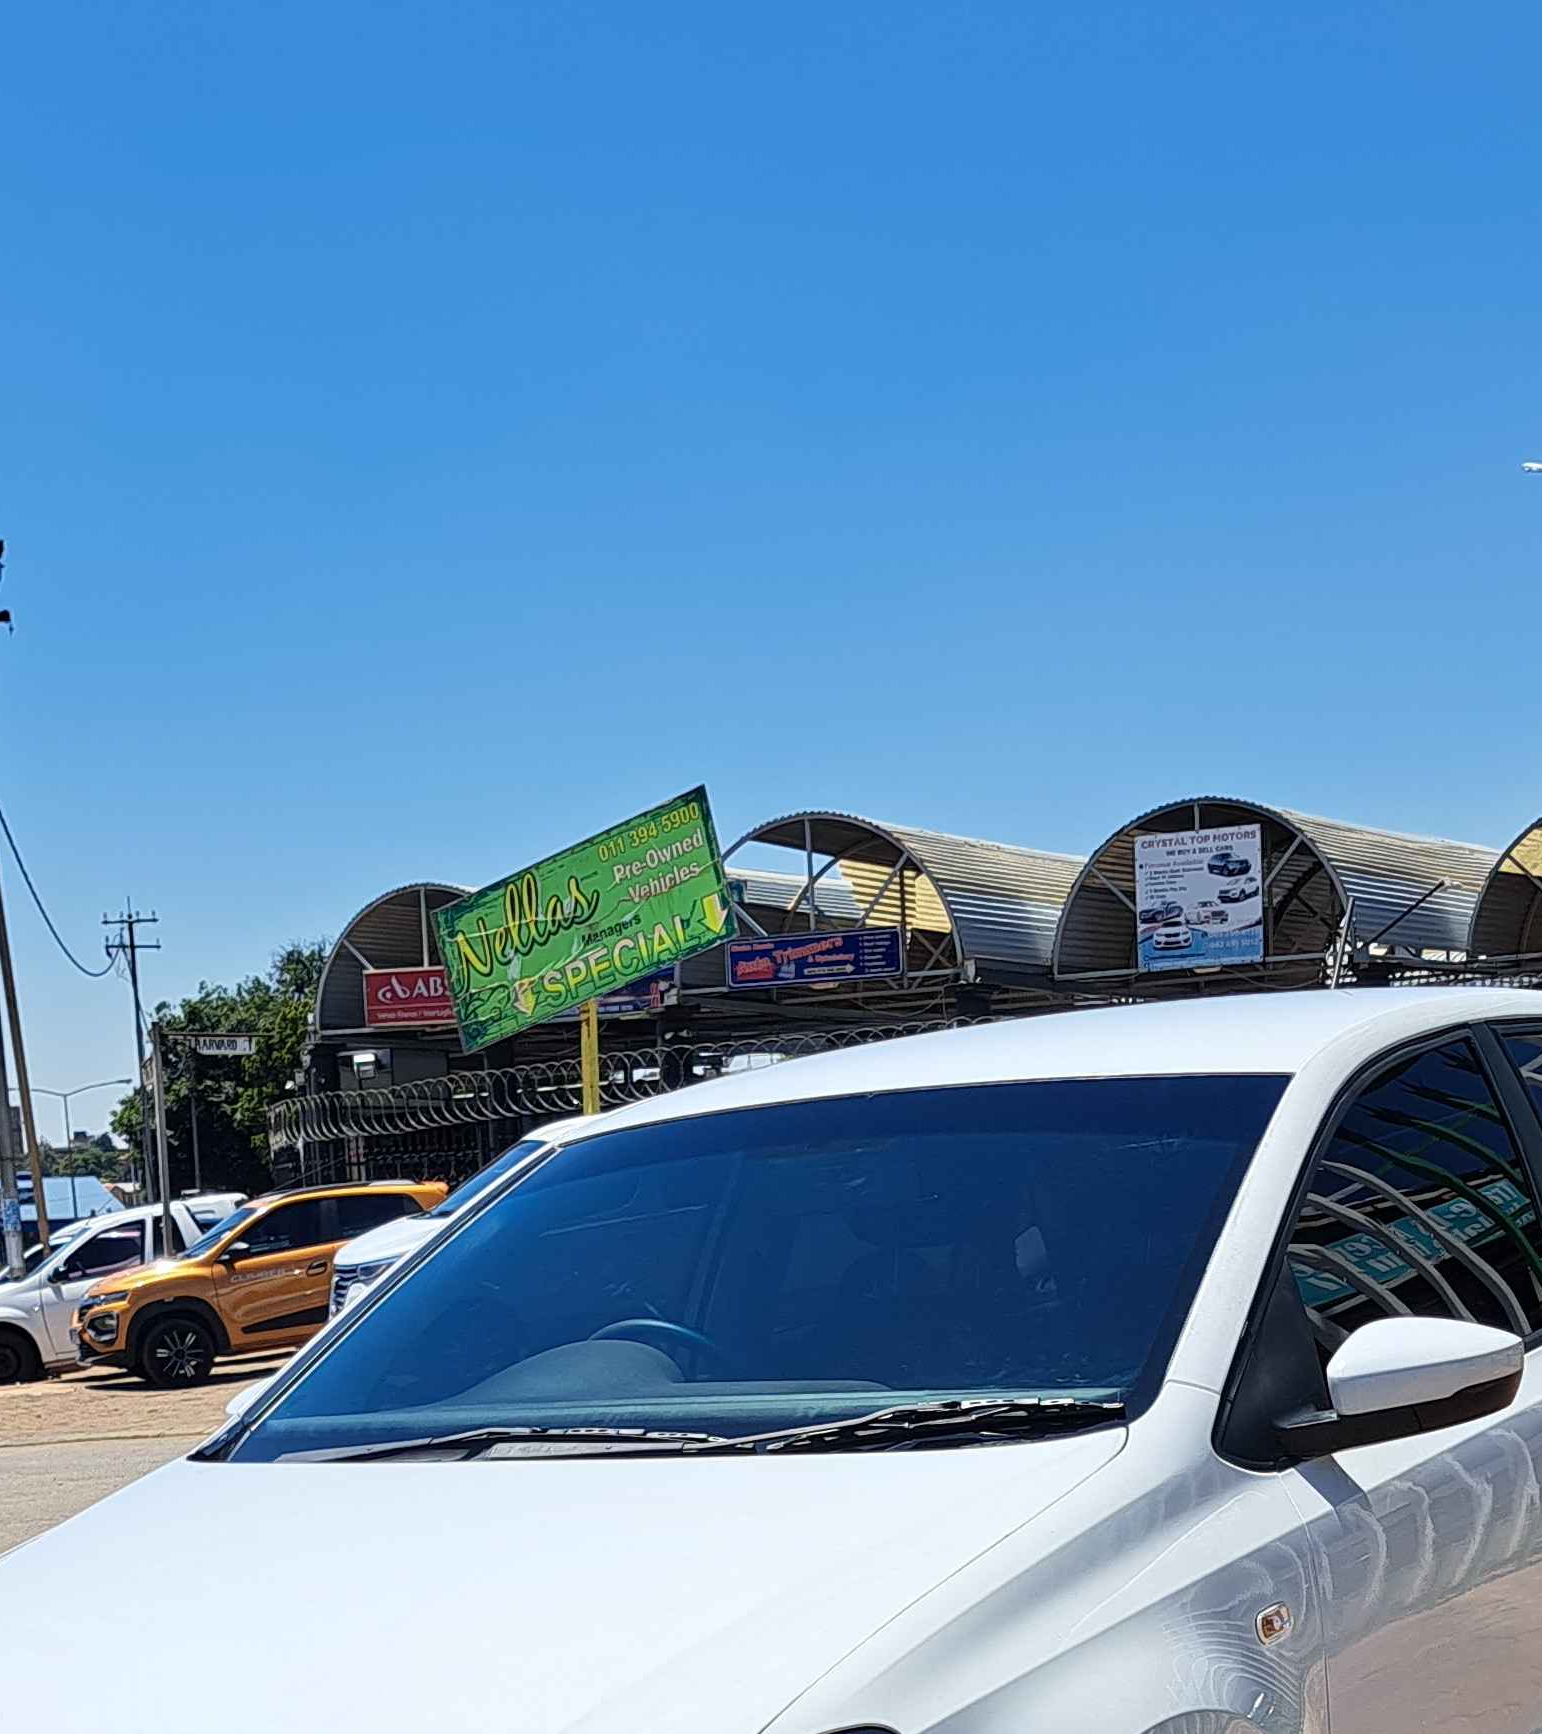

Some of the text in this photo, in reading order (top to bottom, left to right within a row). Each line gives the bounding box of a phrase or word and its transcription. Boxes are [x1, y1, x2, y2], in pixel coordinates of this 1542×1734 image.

[598, 801, 700, 862] 011 394 5900
[613, 828, 704, 884] Pre-Owned
[1141, 830, 1257, 849] CRYSTAL TOP MOTORS
[628, 862, 700, 903] Vehicles
[458, 870, 600, 998] Nellas
[581, 914, 641, 945] Managers
[542, 914, 701, 1006] SPECIAL
